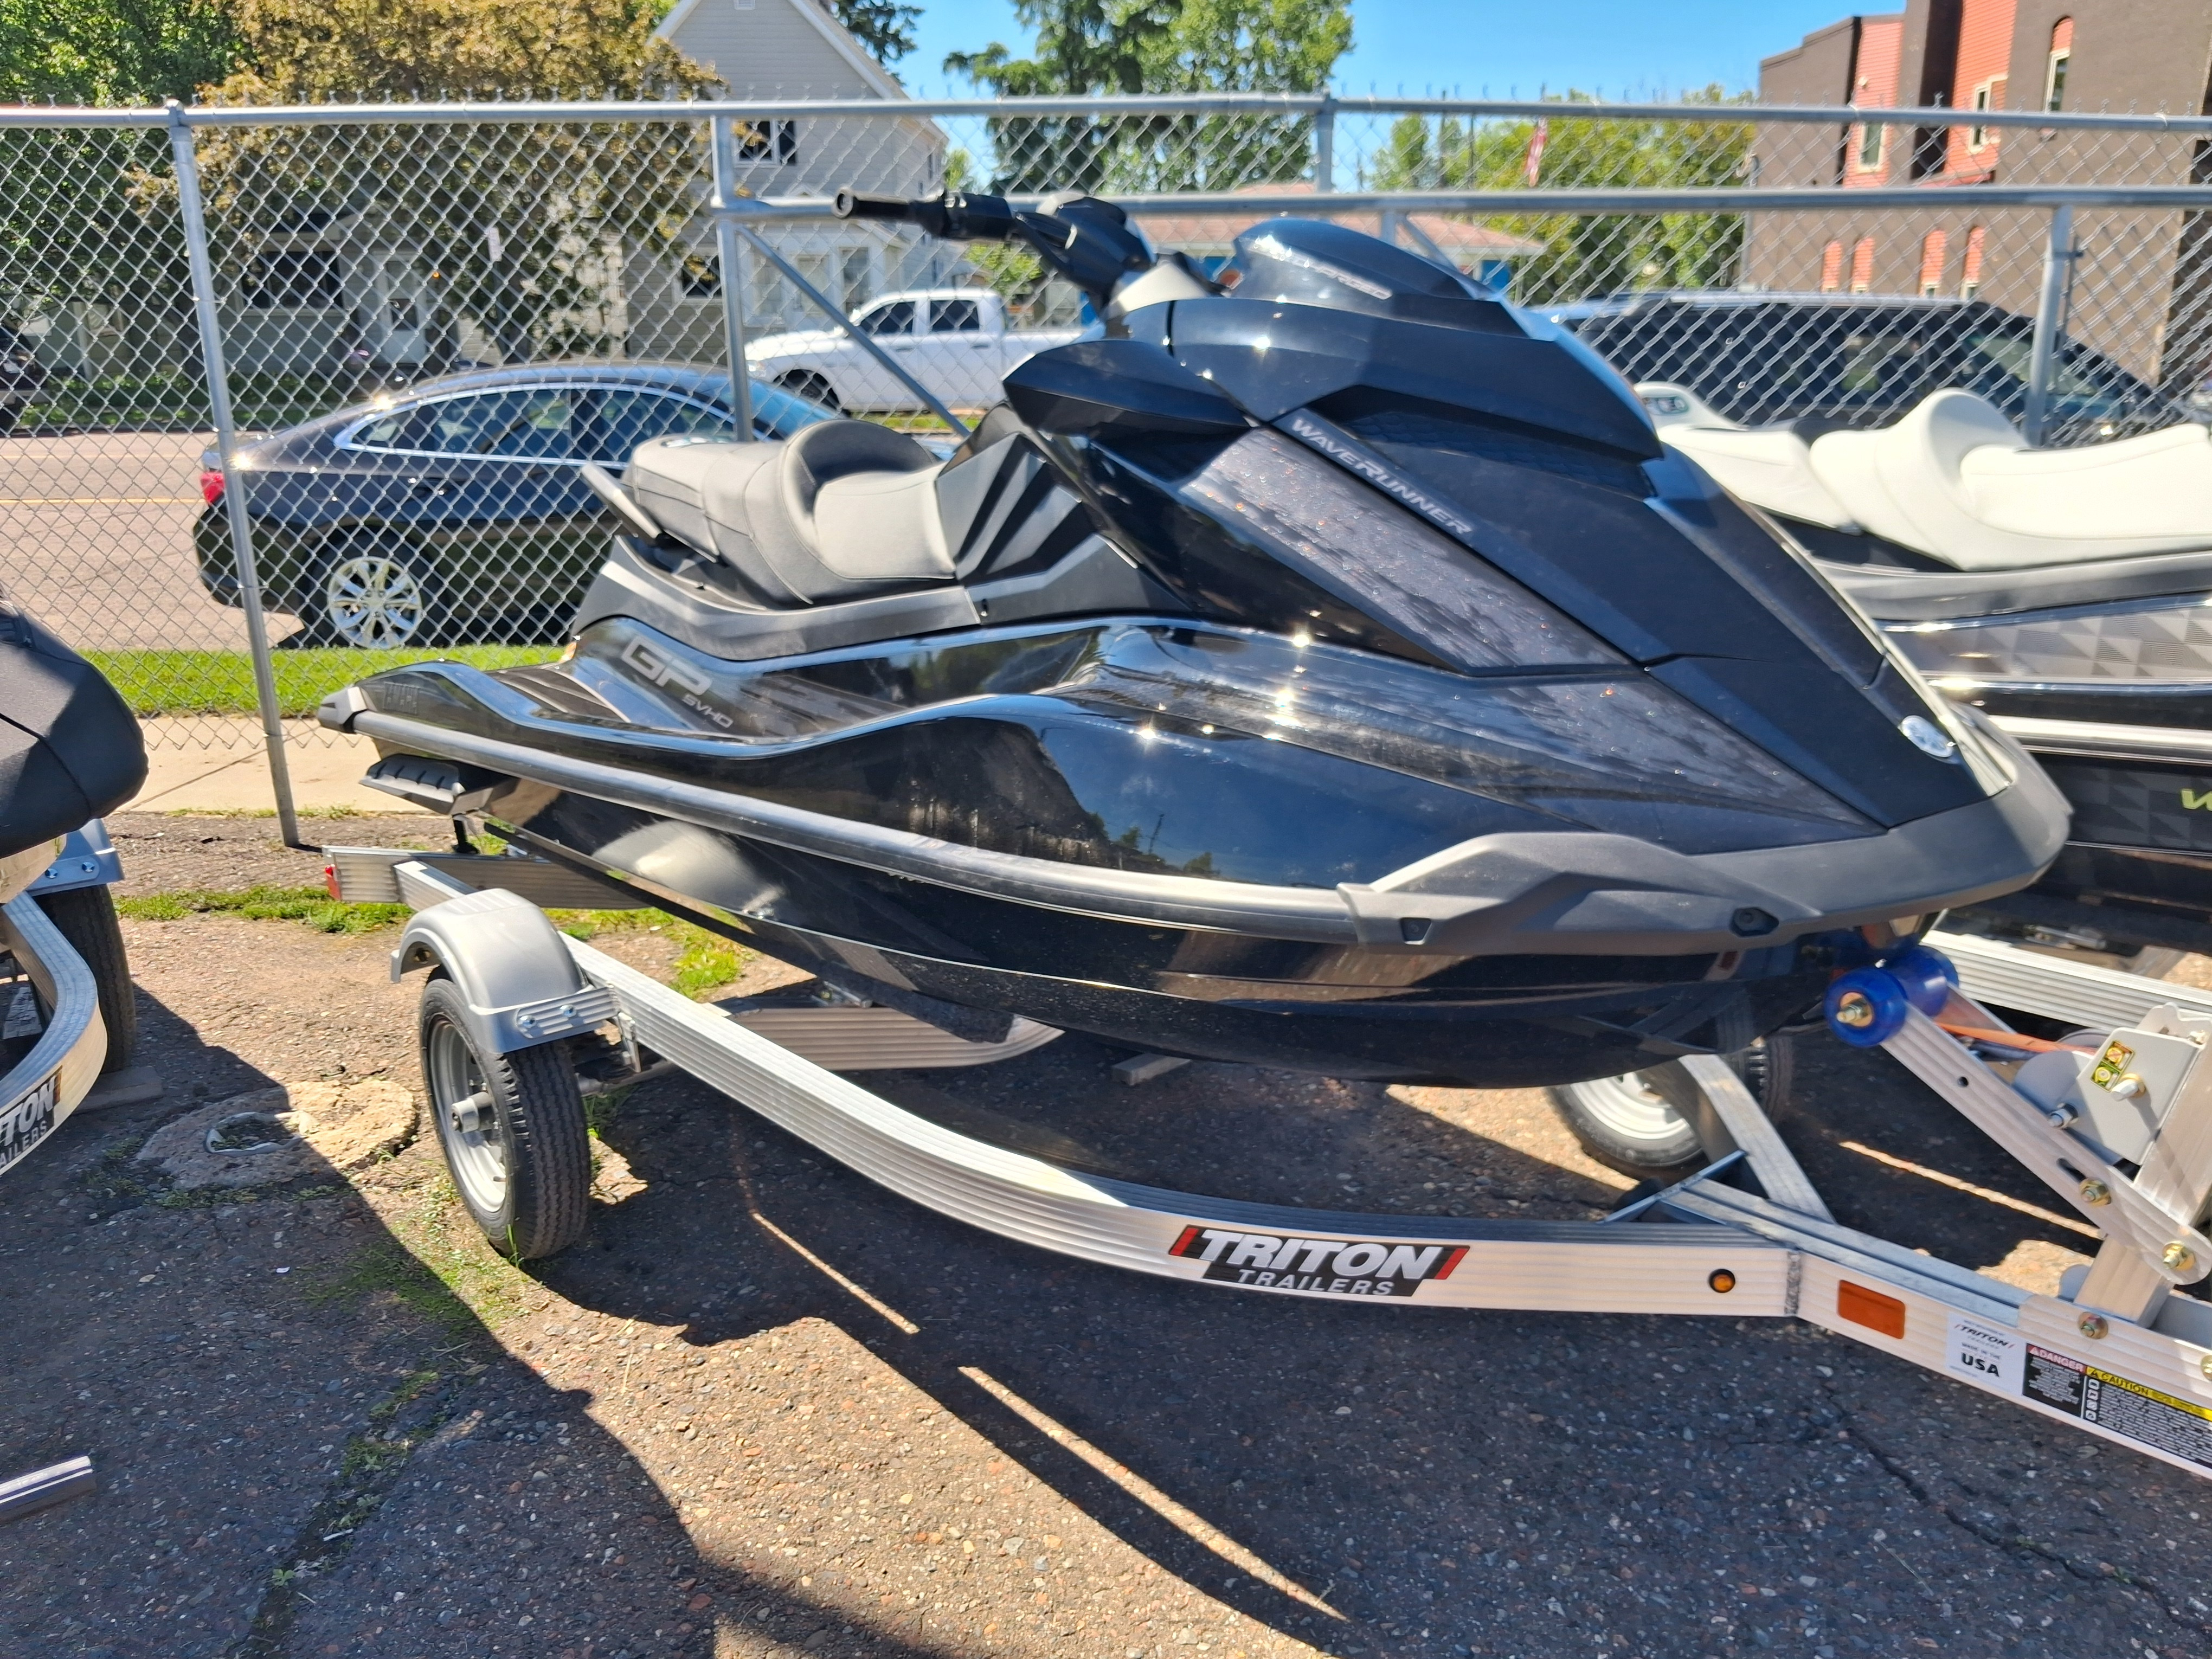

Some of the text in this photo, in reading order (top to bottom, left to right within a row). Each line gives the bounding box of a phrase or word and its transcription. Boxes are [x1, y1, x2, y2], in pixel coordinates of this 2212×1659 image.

[1291, 419, 1473, 535] WAVERUNNER
[620, 635, 712, 696] GP
[1199, 1229, 1443, 1279] TRITON
[1237, 1269, 1395, 1296] TRAILERS
[1960, 1326, 2009, 1346] TRITON
[1961, 1352, 2000, 1377] USA
[2040, 1347, 2085, 1372] DANGER
[2101, 1372, 2149, 1396] CAUTION
